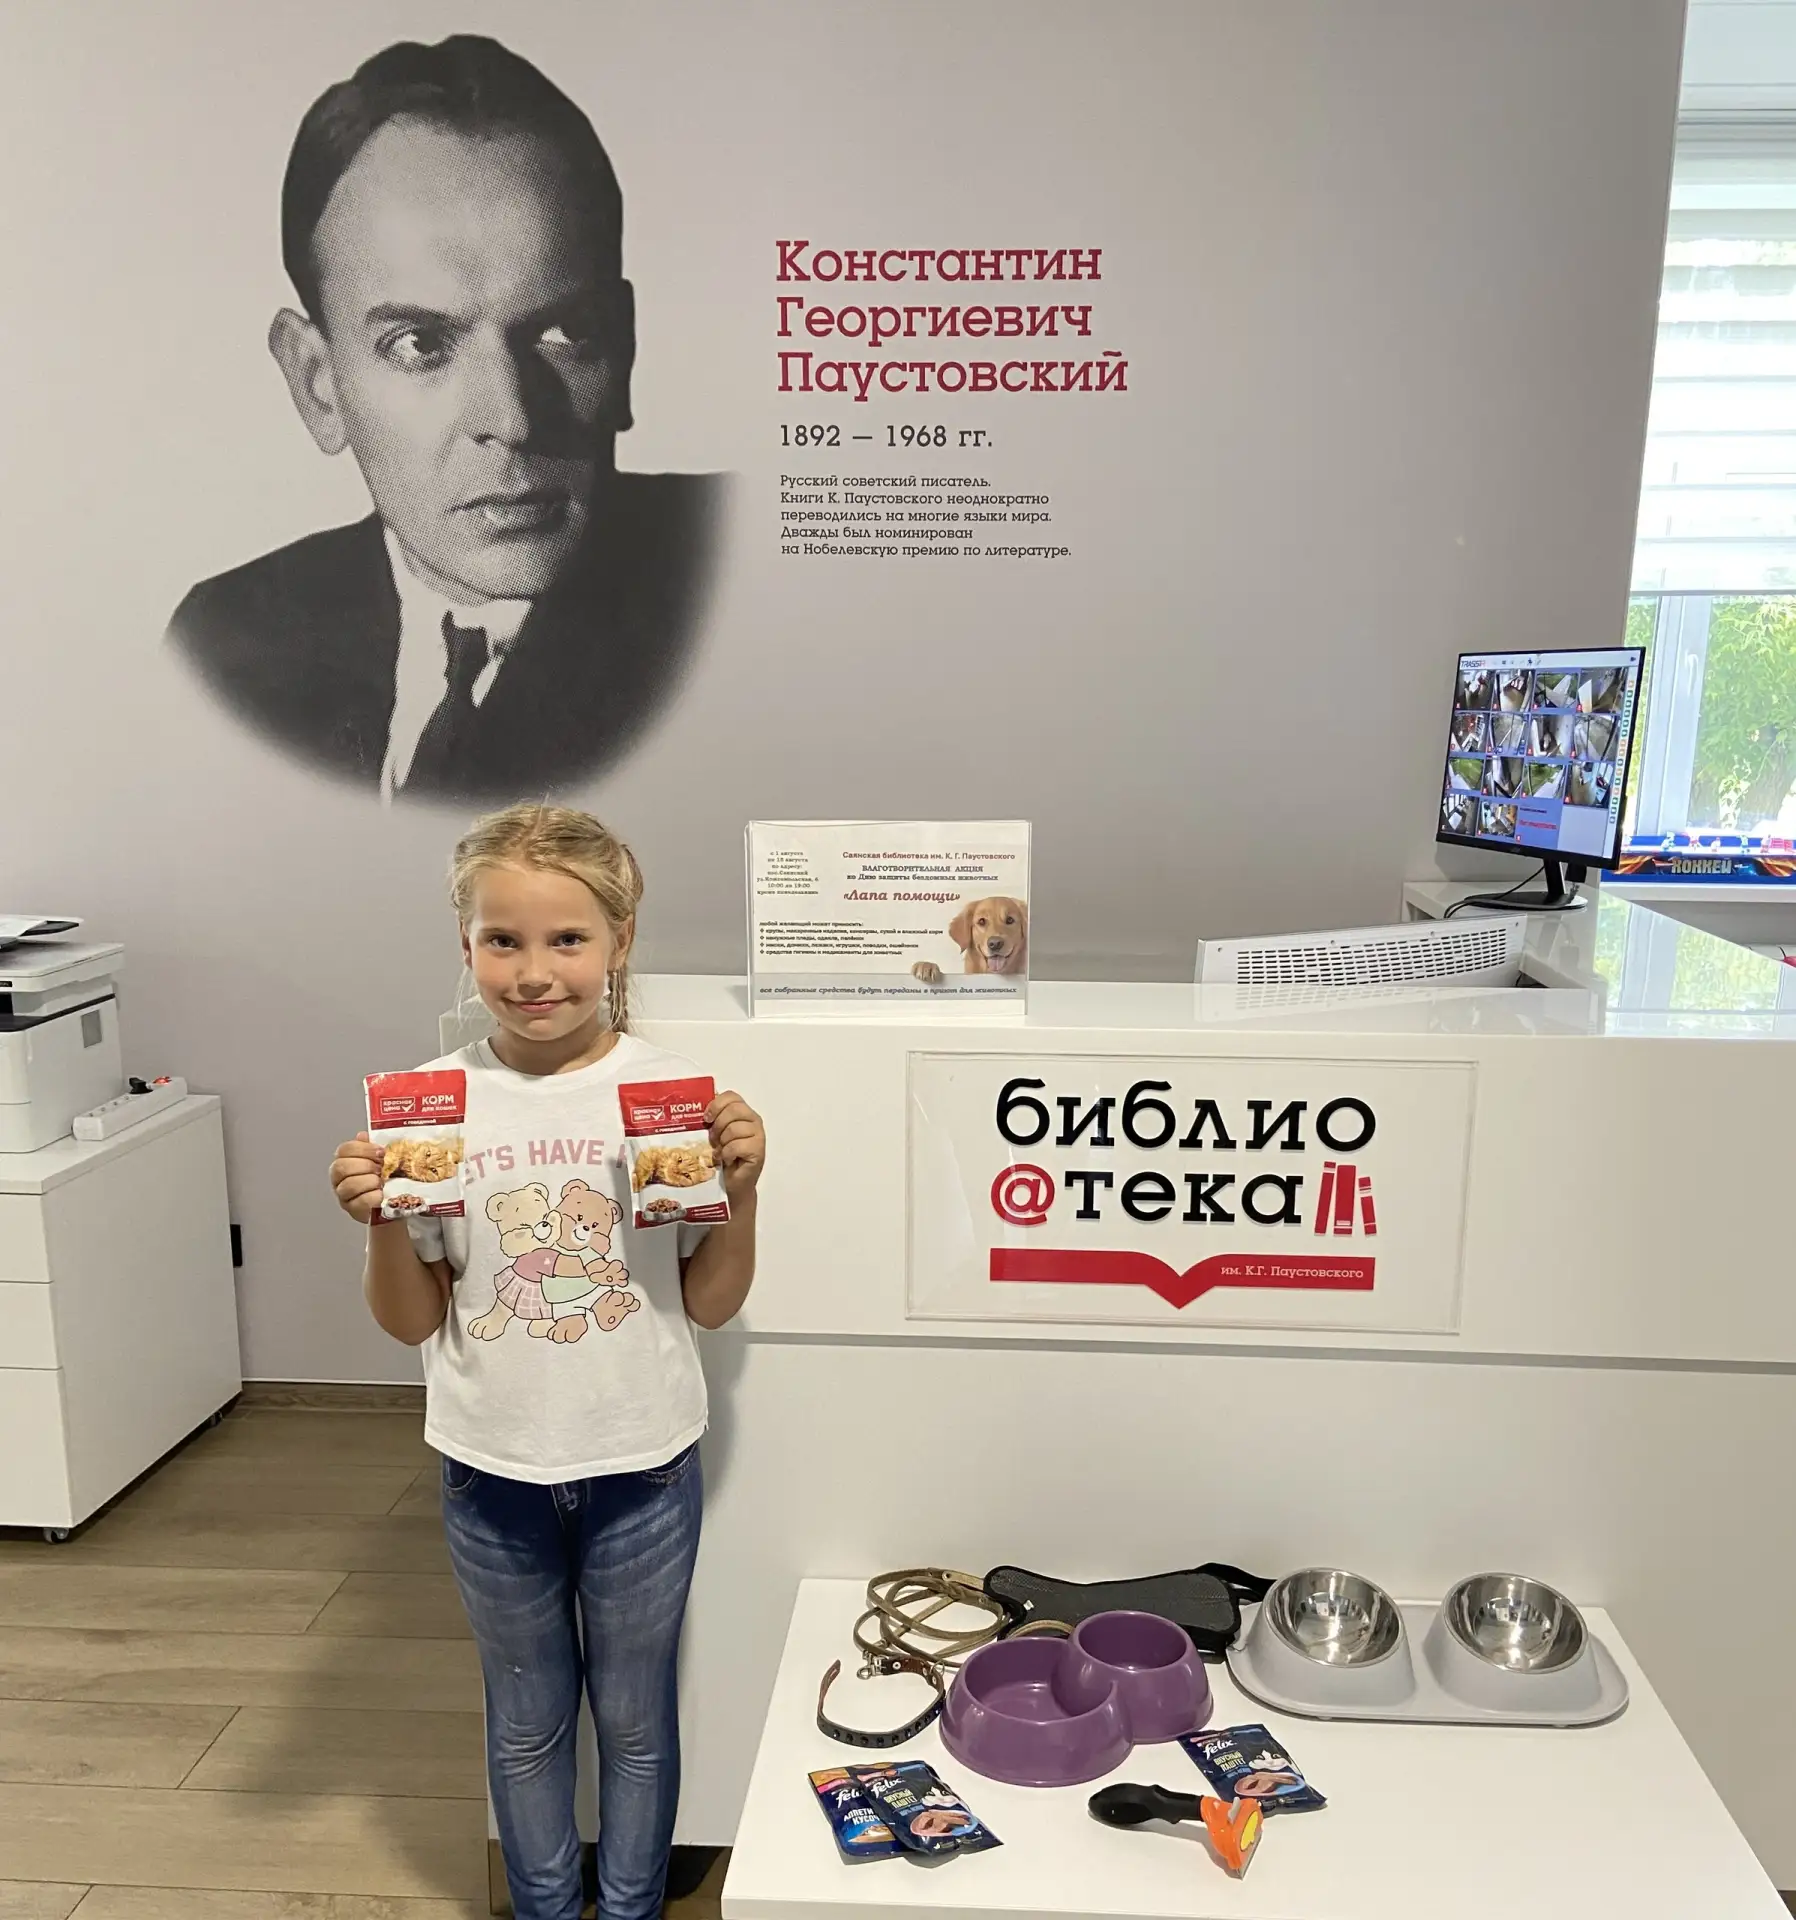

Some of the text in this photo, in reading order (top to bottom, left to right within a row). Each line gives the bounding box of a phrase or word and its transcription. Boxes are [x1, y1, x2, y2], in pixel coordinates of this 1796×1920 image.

[776, 240, 1102, 282] Константин
[777, 296, 1092, 348] Георгиевич
[778, 350, 1128, 403] Паустовский
[781, 424, 840, 447] 1892
[887, 424, 946, 448] 1968
[959, 430, 992, 448] гг.
[781, 474, 990, 489] Русский советский писатель.
[781, 491, 1049, 508] Книги К. Паустовского неоднократно
[781, 511, 1051, 525] переводились на многие языки мира.
[781, 525, 973, 541] Дважды был номинирован
[782, 543, 1071, 559] на Нобелевскую премию по литературе.
[842, 851, 881, 859] Саянская
[882, 851, 929, 860] библиотека
[961, 852, 1016, 861] Паустовского
[844, 890, 960, 903] «Лапа помощи»
[422, 1095, 454, 1105] КОРМ
[670, 1102, 702, 1114] КОРМ
[997, 1078, 1376, 1151] библио
[528, 1139, 604, 1166] HAVE
[1220, 1265, 1364, 1279] им. К.Г. Паустовского
[1203, 1739, 1235, 1760] felix
[871, 1777, 903, 1798] felix
